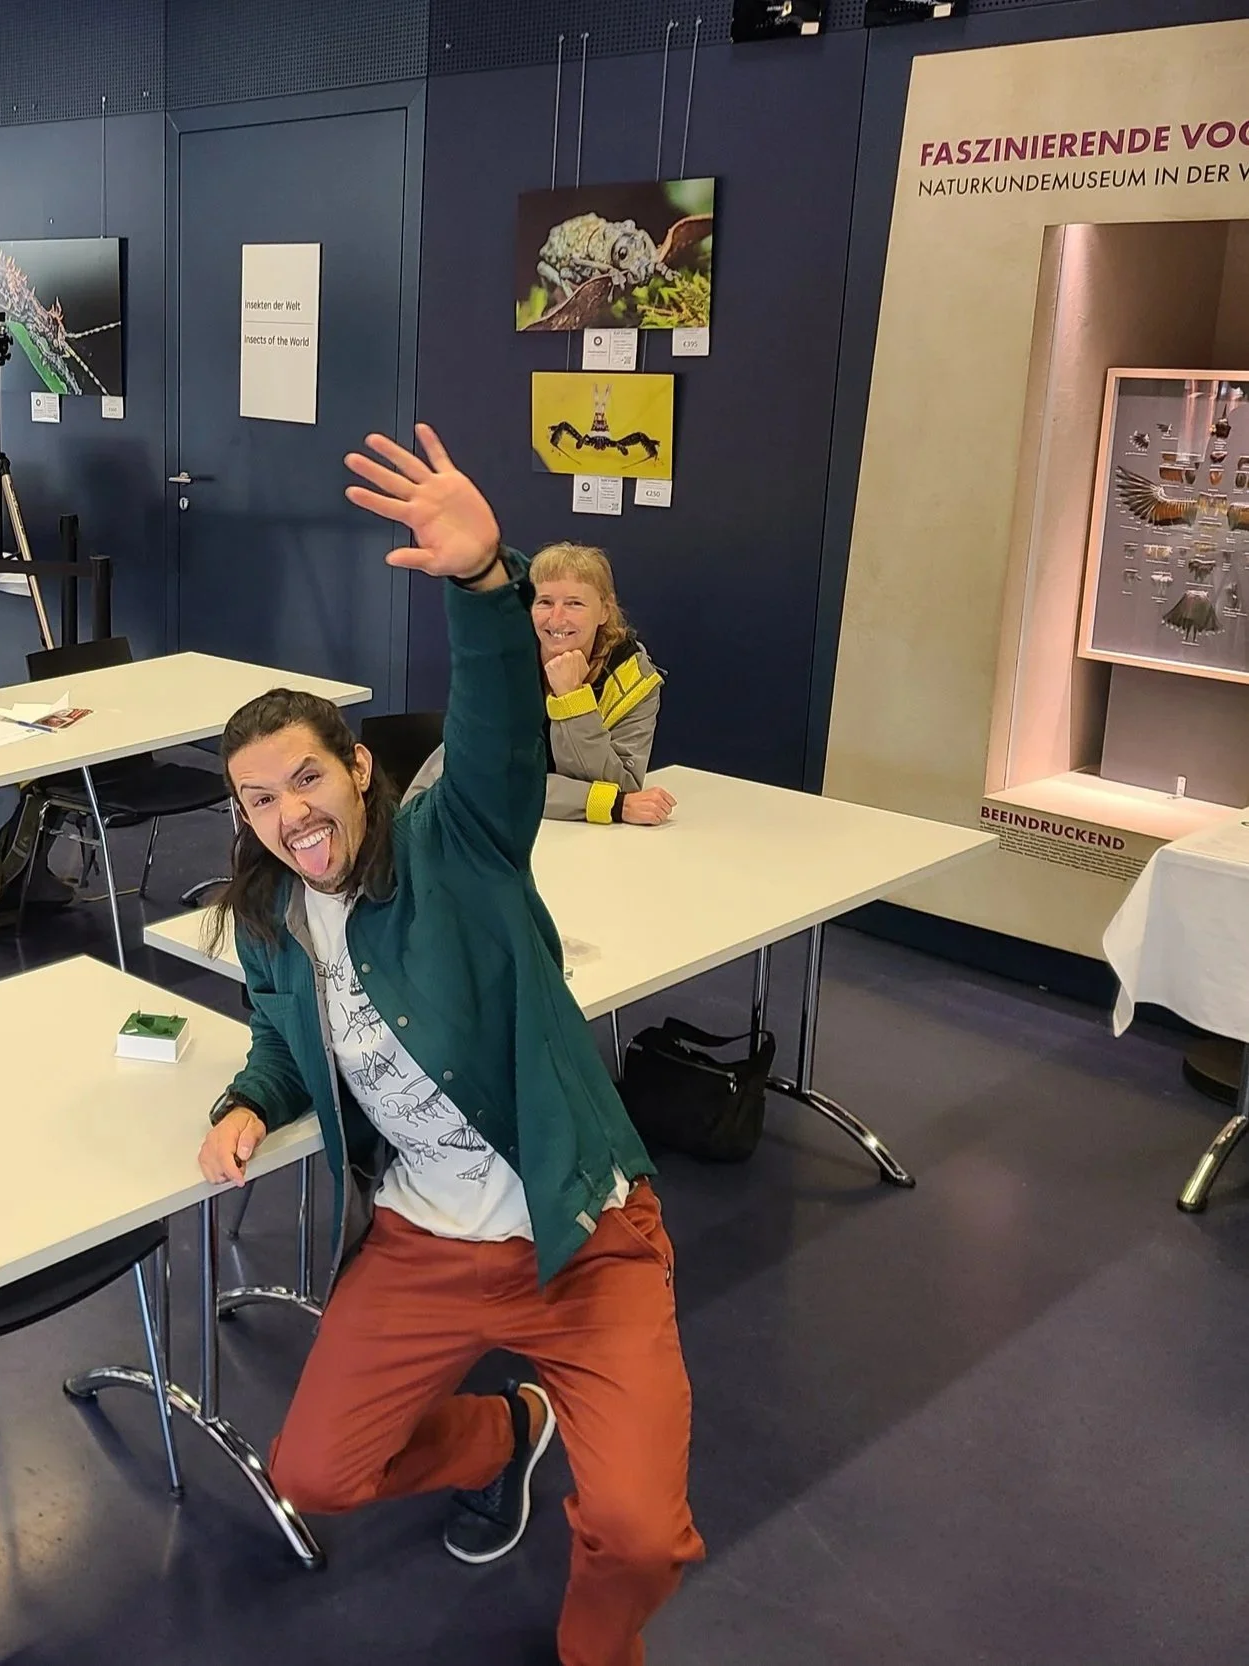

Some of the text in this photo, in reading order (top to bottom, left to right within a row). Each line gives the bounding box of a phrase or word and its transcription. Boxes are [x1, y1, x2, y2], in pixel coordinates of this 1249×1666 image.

[920, 125, 1171, 167] FASZINIERENDE
[918, 169, 1147, 197] NATURKUNDEMUSEUM
[1154, 166, 1179, 185] IN
[1186, 164, 1230, 184] DER
[245, 299, 301, 311] Insekten der Welt
[244, 334, 310, 347] Insects of the World
[980, 805, 1126, 851] BEEINDRUCKEND
